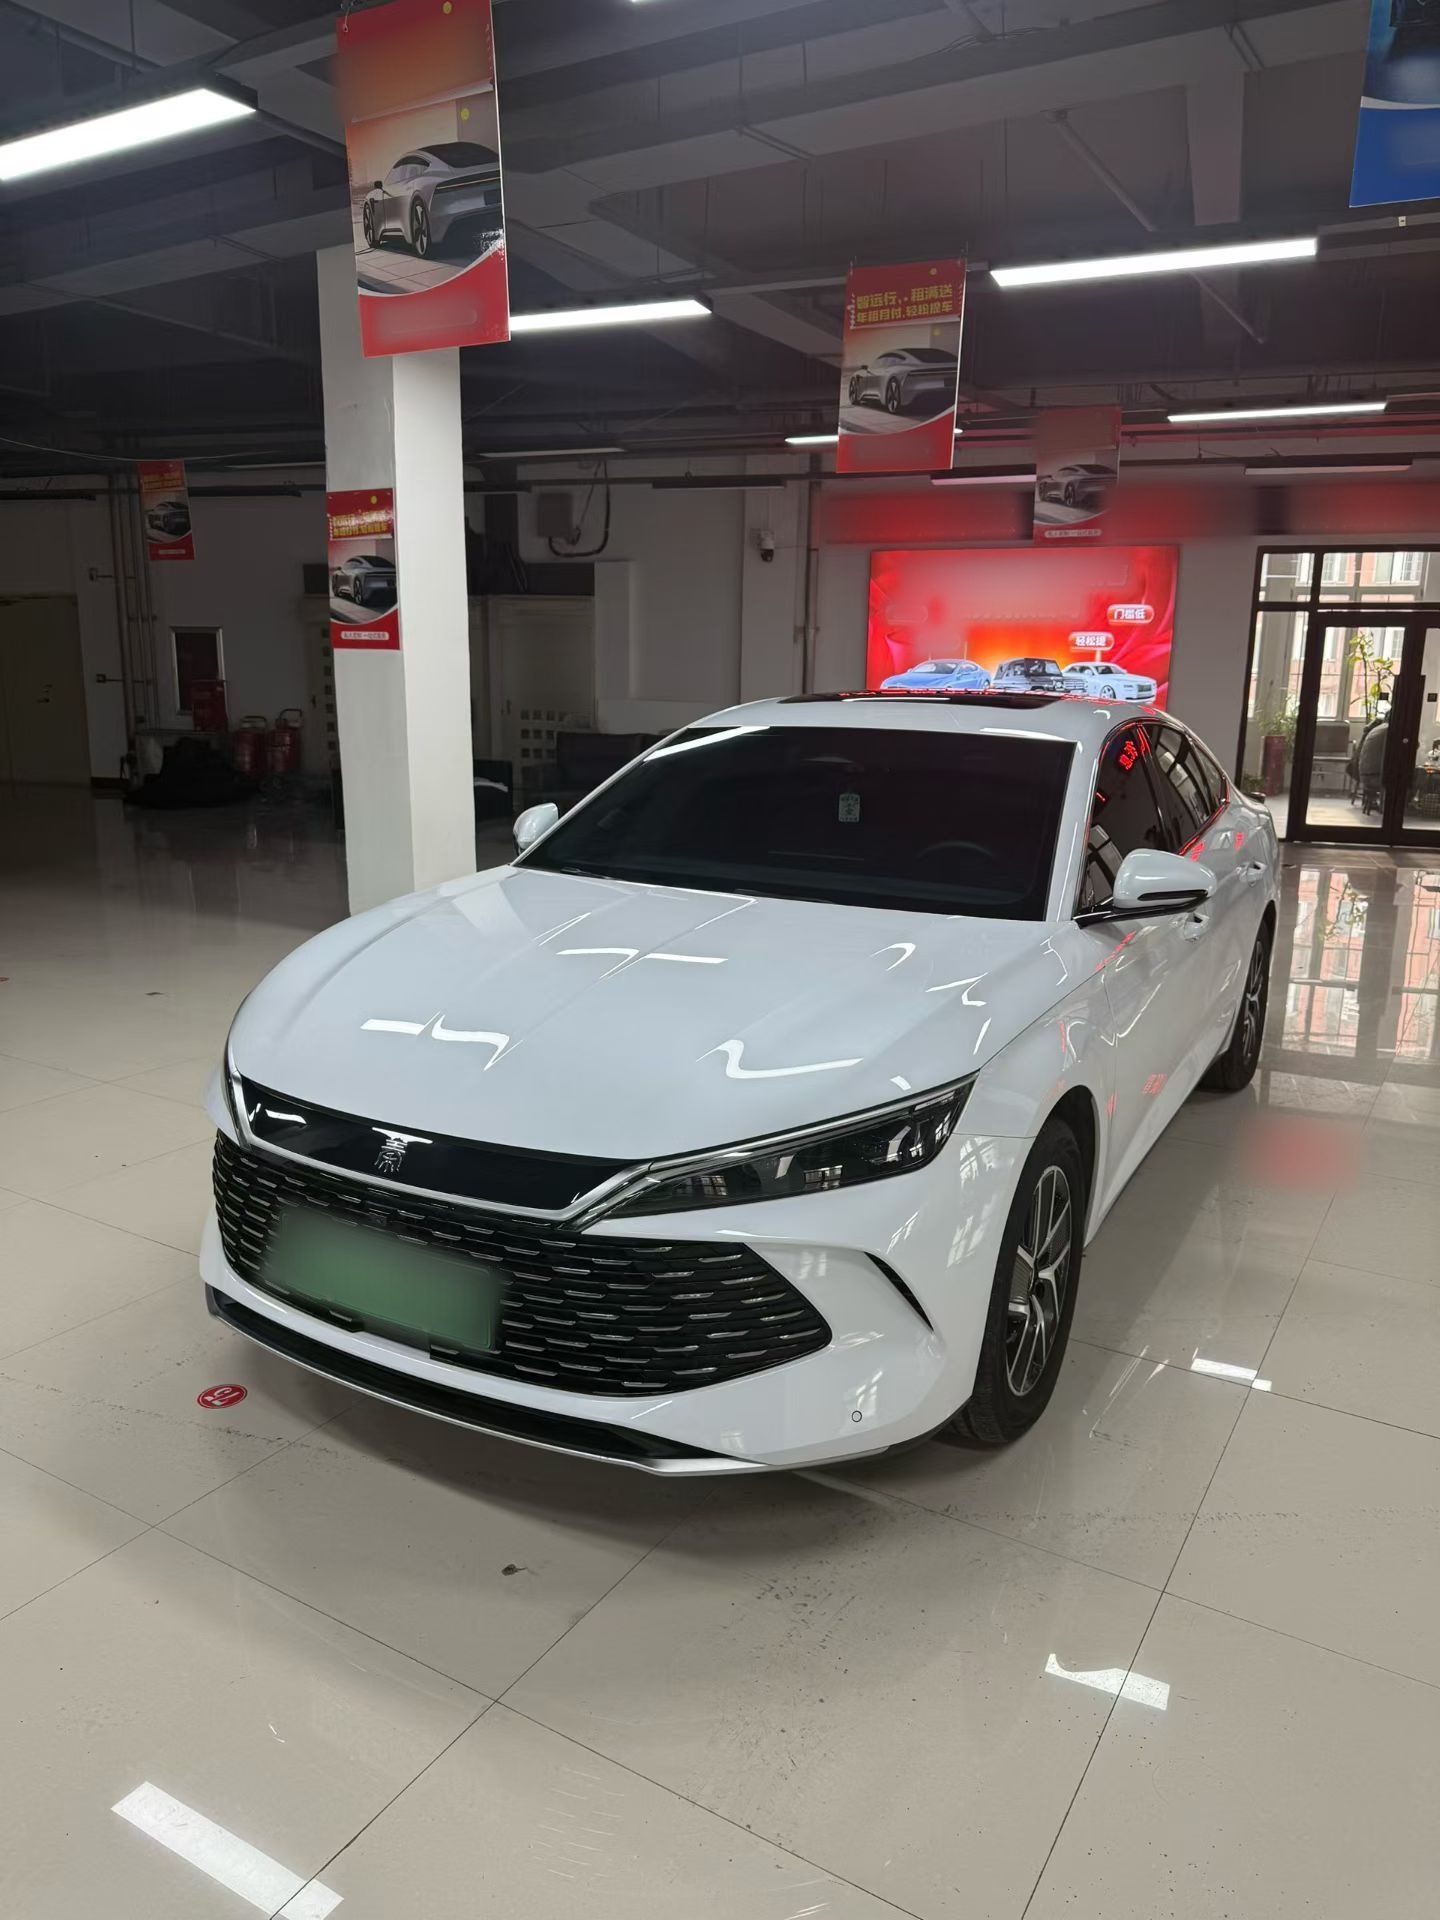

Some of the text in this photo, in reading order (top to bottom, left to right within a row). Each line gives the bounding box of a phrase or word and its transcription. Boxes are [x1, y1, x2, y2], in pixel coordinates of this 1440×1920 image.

[1114, 607, 1145, 620] 门槛低
[1075, 635, 1107, 647] 轻松提
